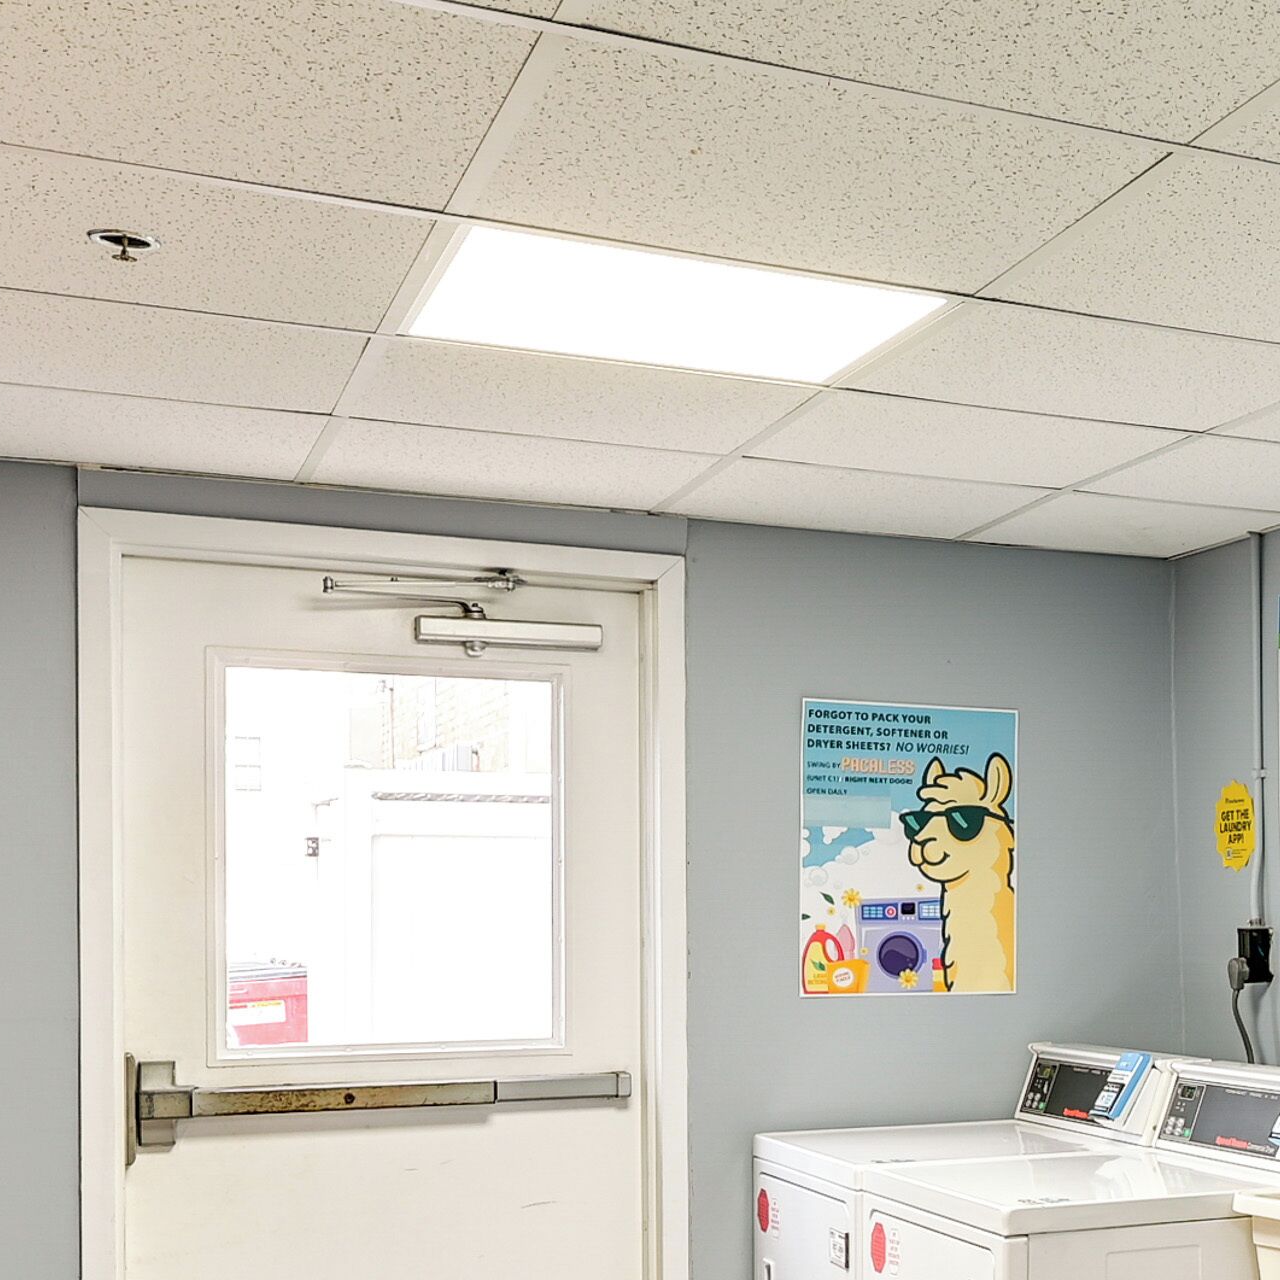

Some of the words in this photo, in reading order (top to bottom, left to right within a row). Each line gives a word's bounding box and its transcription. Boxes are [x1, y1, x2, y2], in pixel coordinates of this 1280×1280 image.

[809, 709, 852, 720] FORGOT
[855, 711, 869, 721] TO
[872, 712, 899, 722] PACK
[901, 714, 931, 724] YOUR
[808, 724, 874, 737] DETERGENT,
[876, 728, 931, 738] SOFTENER
[933, 730, 948, 740] OR
[807, 738, 843, 750] DRYER
[846, 741, 891, 751] SHEETS?
[895, 742, 914, 752] NO
[916, 743, 970, 755] WORRIES!
[1220, 810, 1234, 822] GET
[1236, 808, 1250, 820] THE
[1220, 820, 1252, 834] LAUNDRY
[1228, 833, 1244, 844] APP!
